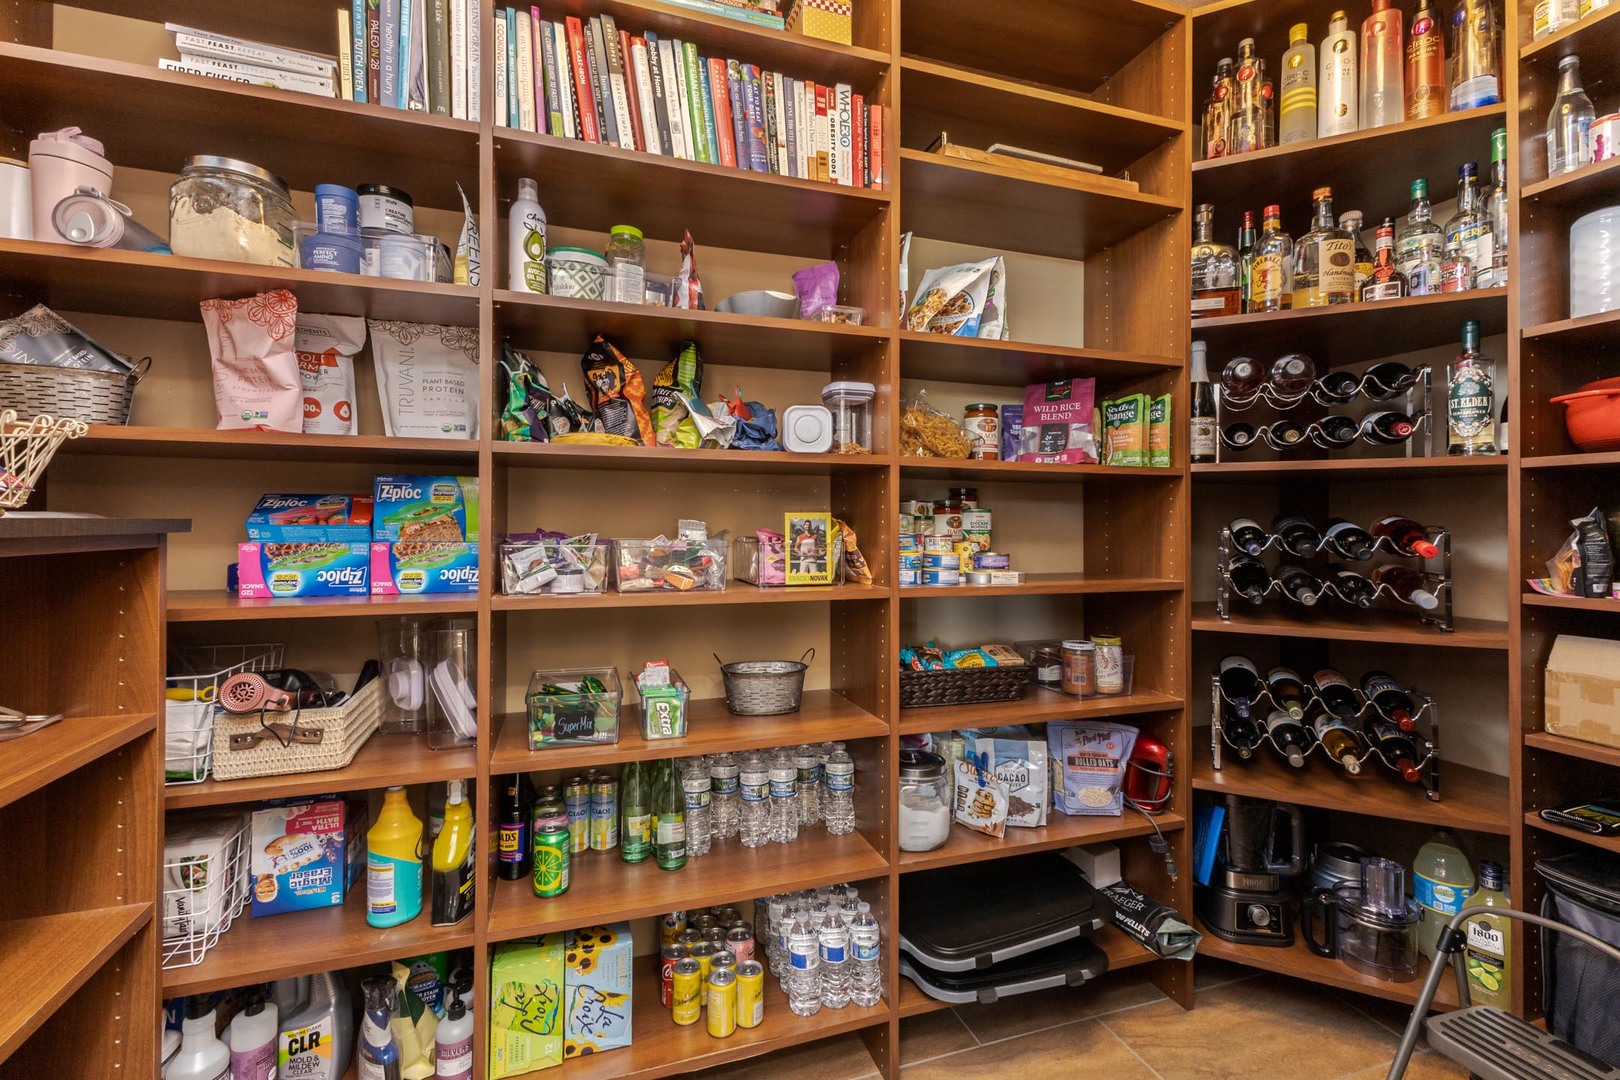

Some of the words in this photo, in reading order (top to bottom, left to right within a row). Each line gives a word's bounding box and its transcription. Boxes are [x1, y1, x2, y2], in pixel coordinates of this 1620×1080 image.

[371, 19, 379, 48] PALEO
[384, 23, 394, 53] healthy
[606, 24, 614, 42] ERIC
[496, 24, 504, 61] COOKING
[545, 37, 554, 63] COMPLETE
[355, 38, 363, 66] DUTCH
[371, 48, 379, 58] IN
[385, 55, 394, 64] in
[609, 44, 618, 67] RIPERT
[647, 42, 659, 65] Bobby
[342, 52, 350, 83] BUBBLY
[371, 58, 380, 70] 28
[547, 64, 555, 80] GUIDE
[575, 50, 585, 84] CAST-IRON
[653, 66, 660, 74] at
[356, 69, 364, 92] OVEN
[519, 55, 530, 105] menopause
[699, 66, 707, 82] The
[384, 72, 395, 96] hurry
[601, 75, 610, 98] bowls
[654, 75, 663, 97] Home
[549, 88, 559, 110] FASTING
[615, 78, 625, 110] SEAFOOD
[700, 83, 712, 121] Galveston
[734, 101, 743, 119] family
[620, 113, 629, 137] SIMPLE
[808, 111, 816, 128] Paleo
[839, 90, 851, 148] WHOLE30
[1452, 224, 1490, 243] APEROL
[313, 249, 338, 257] PERFECT
[467, 218, 480, 287] REENS
[1326, 241, 1353, 251] Tito's
[398, 349, 415, 416] TRUVANI
[422, 386, 464, 395] PROTEIN
[1033, 405, 1056, 413] WILD
[1059, 402, 1081, 411] RICE
[1450, 398, 1460, 409] ST.
[1459, 396, 1487, 407] ELDER
[1040, 412, 1072, 421] BLEND
[381, 485, 422, 502] Ziploc
[264, 499, 308, 508] Ziploc
[317, 567, 363, 585] Ziploc
[1082, 735, 1097, 746] Red
[1075, 758, 1097, 766] ROLLED
[997, 772, 1026, 783] CACAO
[316, 816, 339, 825] BATH
[568, 809, 588, 817] CIAO!
[311, 822, 339, 831] ULTRA
[290, 844, 313, 857] 100%
[289, 867, 332, 880] Eraser
[289, 875, 332, 889] Magic
[1243, 877, 1264, 888] NINJA
[331, 894, 340, 903] 3
[1124, 917, 1151, 937] PELLETS
[424, 989, 439, 997] STAIN
[501, 990, 533, 1016] La
[520, 984, 553, 1036] Croix
[576, 984, 607, 1036] Croix
[595, 1006, 624, 1028] La
[306, 1024, 321, 1032] CLEAN
[288, 1031, 320, 1056] CLR
[545, 1043, 553, 1054] 12
[288, 1061, 320, 1071] MILDEW
[289, 1056, 313, 1065] MOLD
